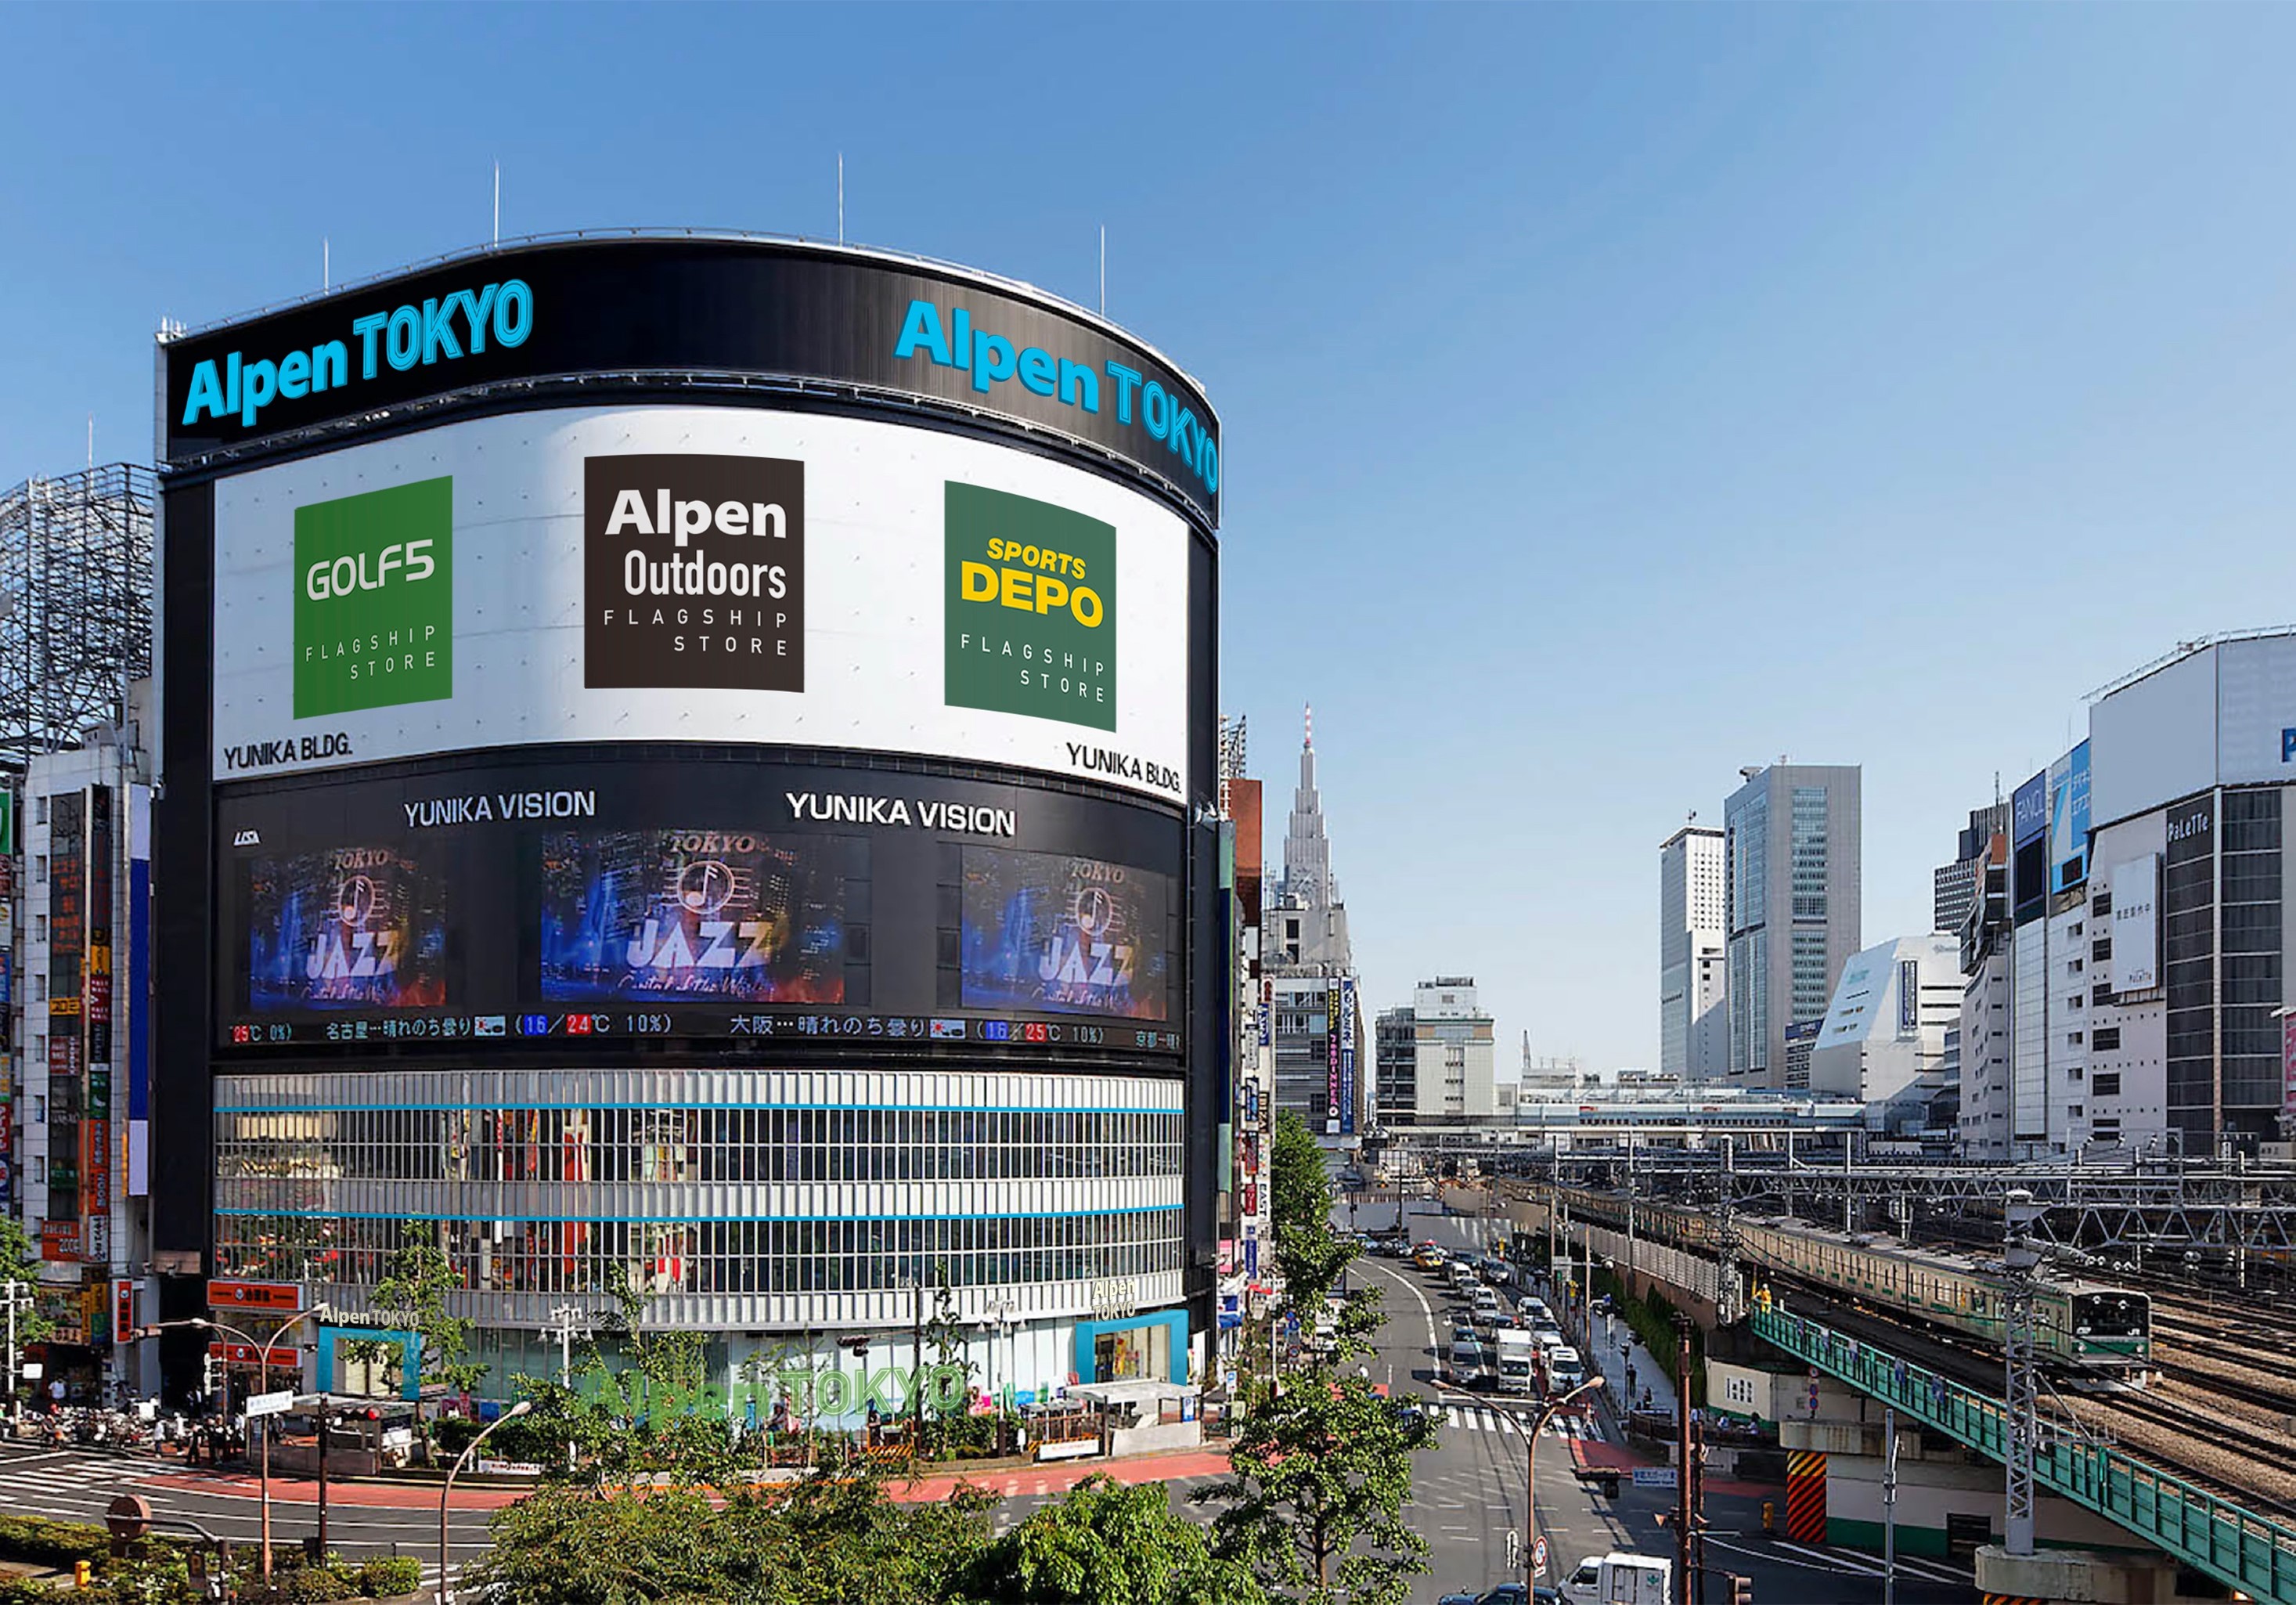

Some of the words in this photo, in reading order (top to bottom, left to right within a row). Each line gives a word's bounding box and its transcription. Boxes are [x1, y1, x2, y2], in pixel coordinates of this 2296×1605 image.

[182, 339, 348, 427] Alpen
[353, 279, 533, 380] TOKYO
[892, 300, 1099, 413] Alpen
[1105, 359, 1219, 495] TOKYO
[604, 488, 786, 546] Alpen
[306, 539, 434, 601] GOLF5
[624, 547, 786, 601] Outdoors
[986, 537, 1086, 580] SPORTS
[961, 560, 1104, 628] DEPO
[604, 608, 787, 629] FLAGSHIP
[305, 625, 435, 662] FLAGSHIP
[674, 636, 787, 656] STORE
[961, 633, 1104, 676] FLAGSHIP
[350, 651, 435, 680] STORE
[1021, 669, 1104, 703] STORE
[224, 739, 297, 770] YUNIKA
[301, 731, 352, 760] BLDG.
[1066, 742, 1143, 781] YUNIKA
[1146, 763, 1181, 795] BLDG.
[405, 795, 493, 828] YUNIKA
[498, 791, 596, 821] VISION
[785, 792, 910, 827] YUNIKA
[917, 800, 1017, 836] VISION
[333, 849, 389, 870] TOKYO
[669, 834, 756, 855] TOKYO
[1070, 861, 1126, 883] TOKYO
[306, 930, 398, 979] JAZZ
[626, 919, 773, 968] JAZZ
[1038, 936, 1134, 986] JAZZ
[627, 1014, 672, 1033] 10%)
[1072, 1026, 1103, 1044] 10%)
[1092, 1279, 1135, 1300] Alpen
[320, 1306, 370, 1327] Alpen
[371, 1308, 420, 1328] TOKYO
[1092, 1301, 1135, 1322] TOKYO
[574, 1369, 770, 1430] Alpen
[780, 1365, 964, 1416] TOKYO
